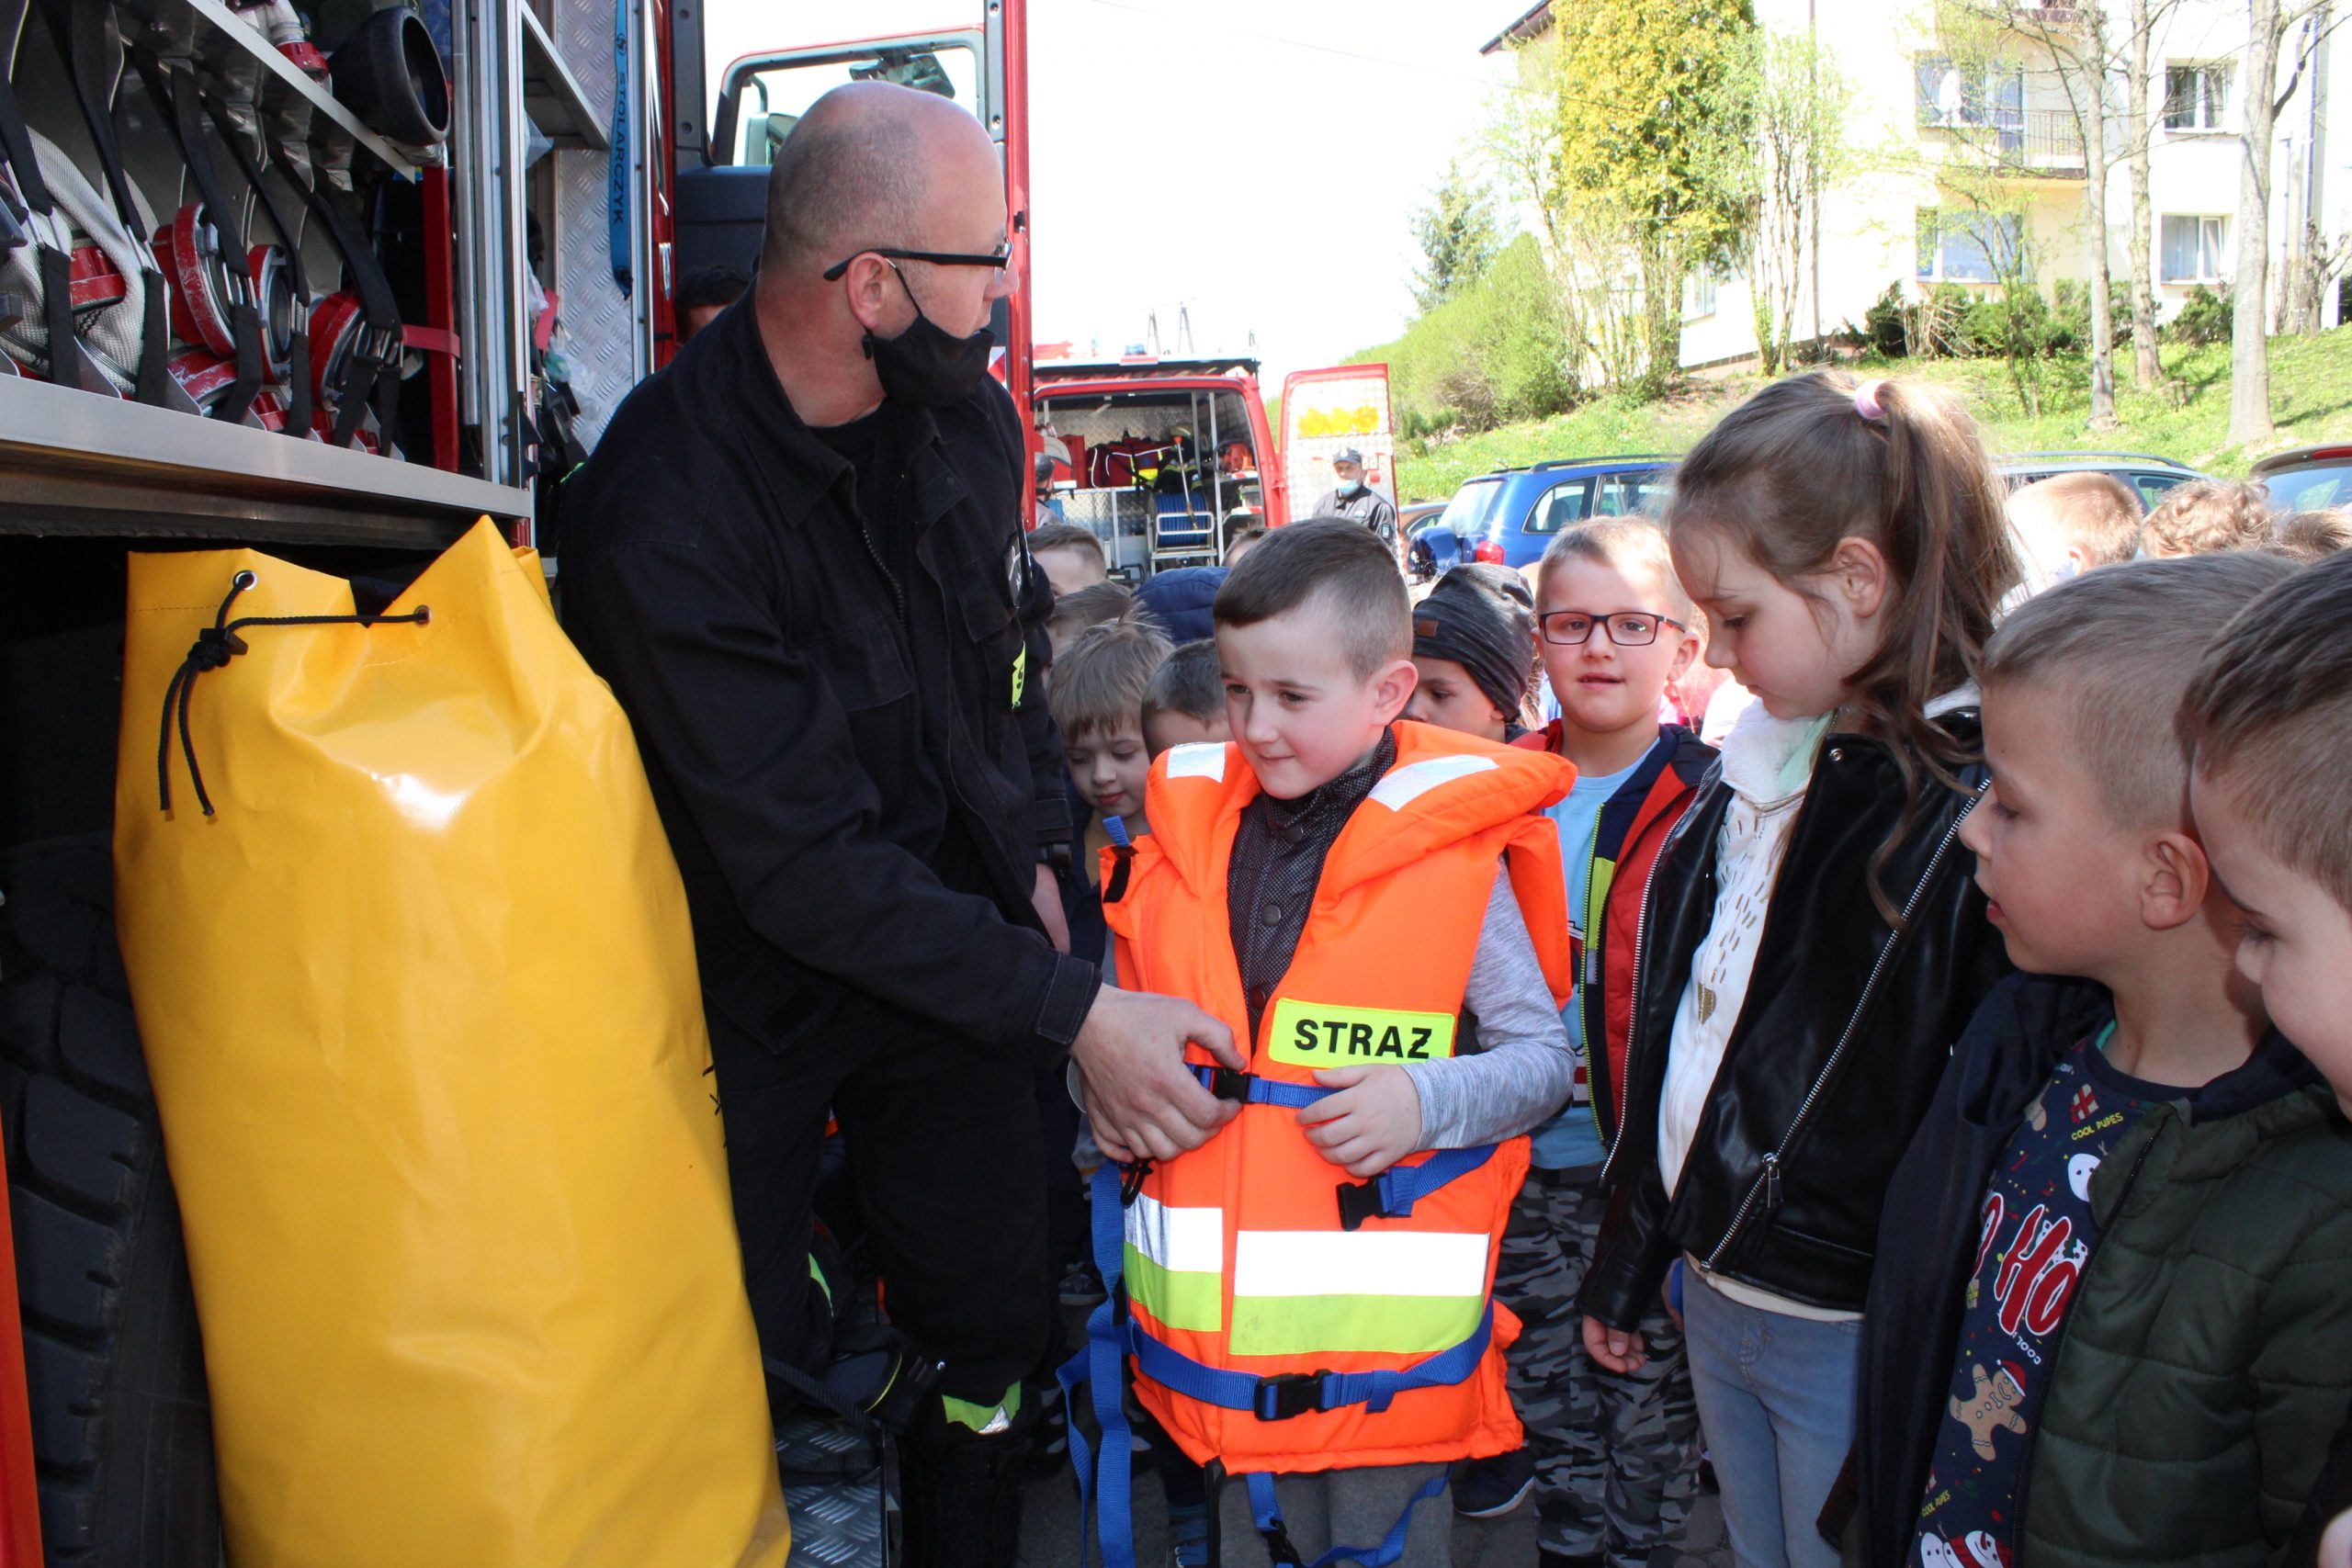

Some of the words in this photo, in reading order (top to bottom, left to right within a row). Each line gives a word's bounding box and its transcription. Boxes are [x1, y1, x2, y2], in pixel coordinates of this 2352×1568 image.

[614, 73, 627, 225] STOLARCZYK
[2071, 1125, 2095, 1141] COOL
[2017, 1336, 2041, 1365] COOL
